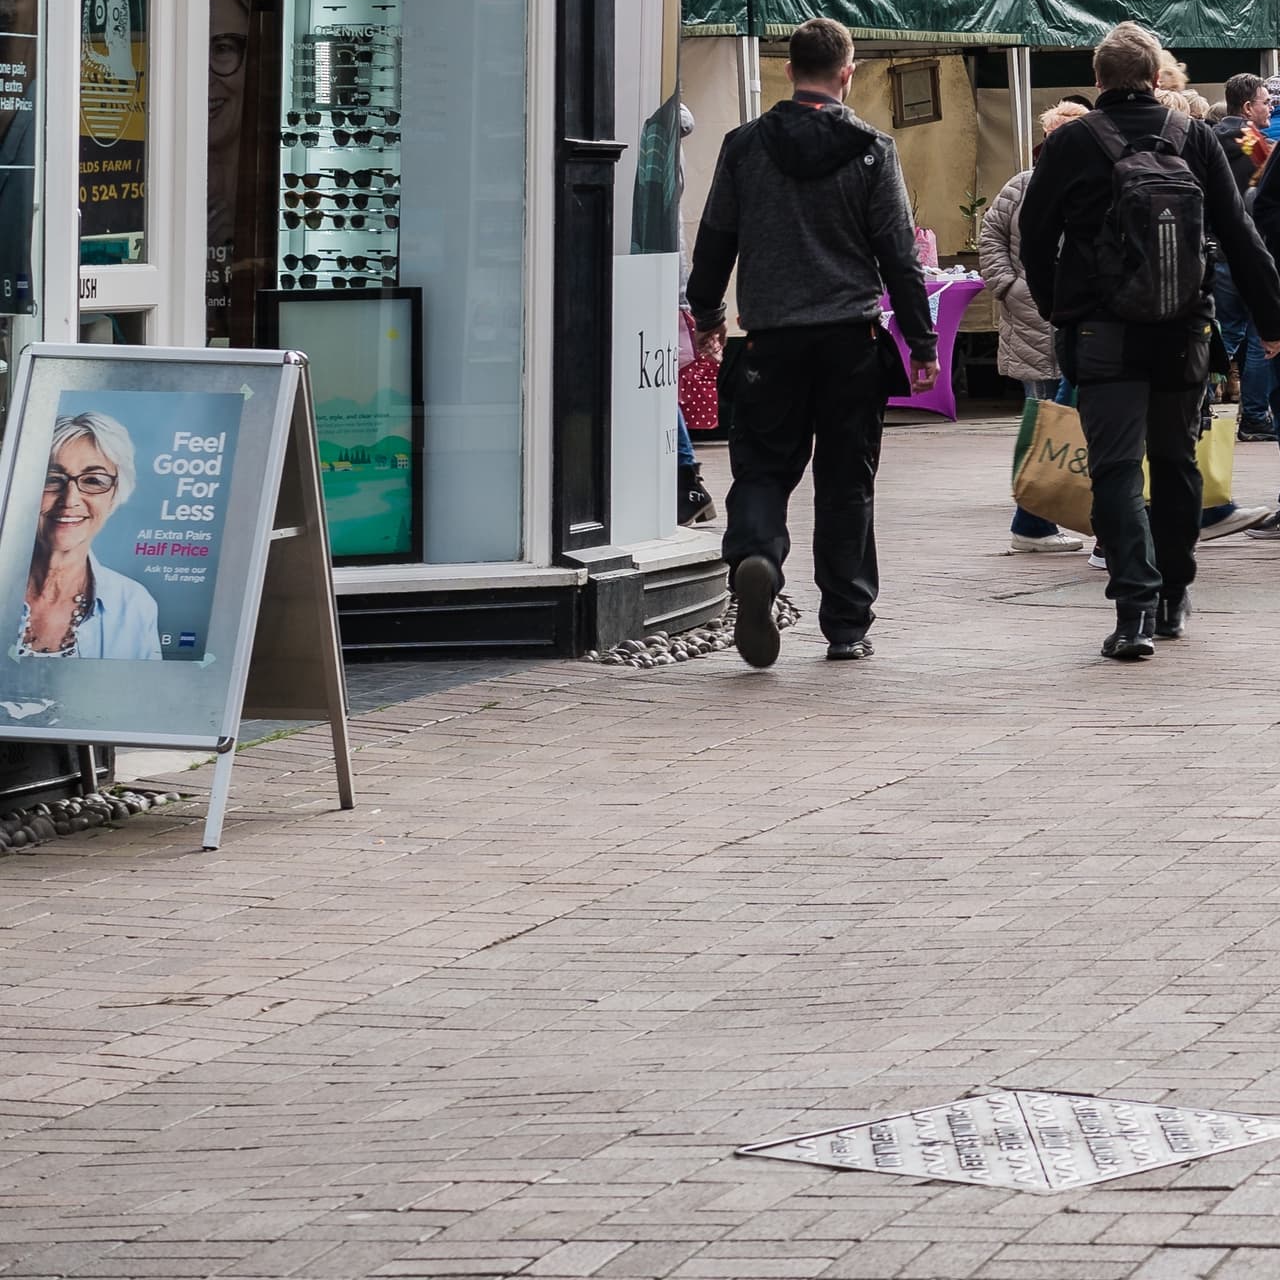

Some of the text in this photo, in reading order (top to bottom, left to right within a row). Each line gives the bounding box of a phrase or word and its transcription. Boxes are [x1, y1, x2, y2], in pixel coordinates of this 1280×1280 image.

[0, 97, 33, 111] Half Price
[102, 160, 132, 173] FARM
[91, 183, 118, 201] 524
[173, 431, 226, 453] Feel
[153, 454, 224, 476] Good
[176, 477, 220, 498] For
[160, 499, 215, 522] Less
[137, 529, 212, 541] All Extra Pairs
[135, 543, 209, 557] Half Price
[144, 565, 162, 574] Ask
[163, 566, 173, 574] to
[191, 567, 207, 575] our
[164, 573, 206, 584] full range
